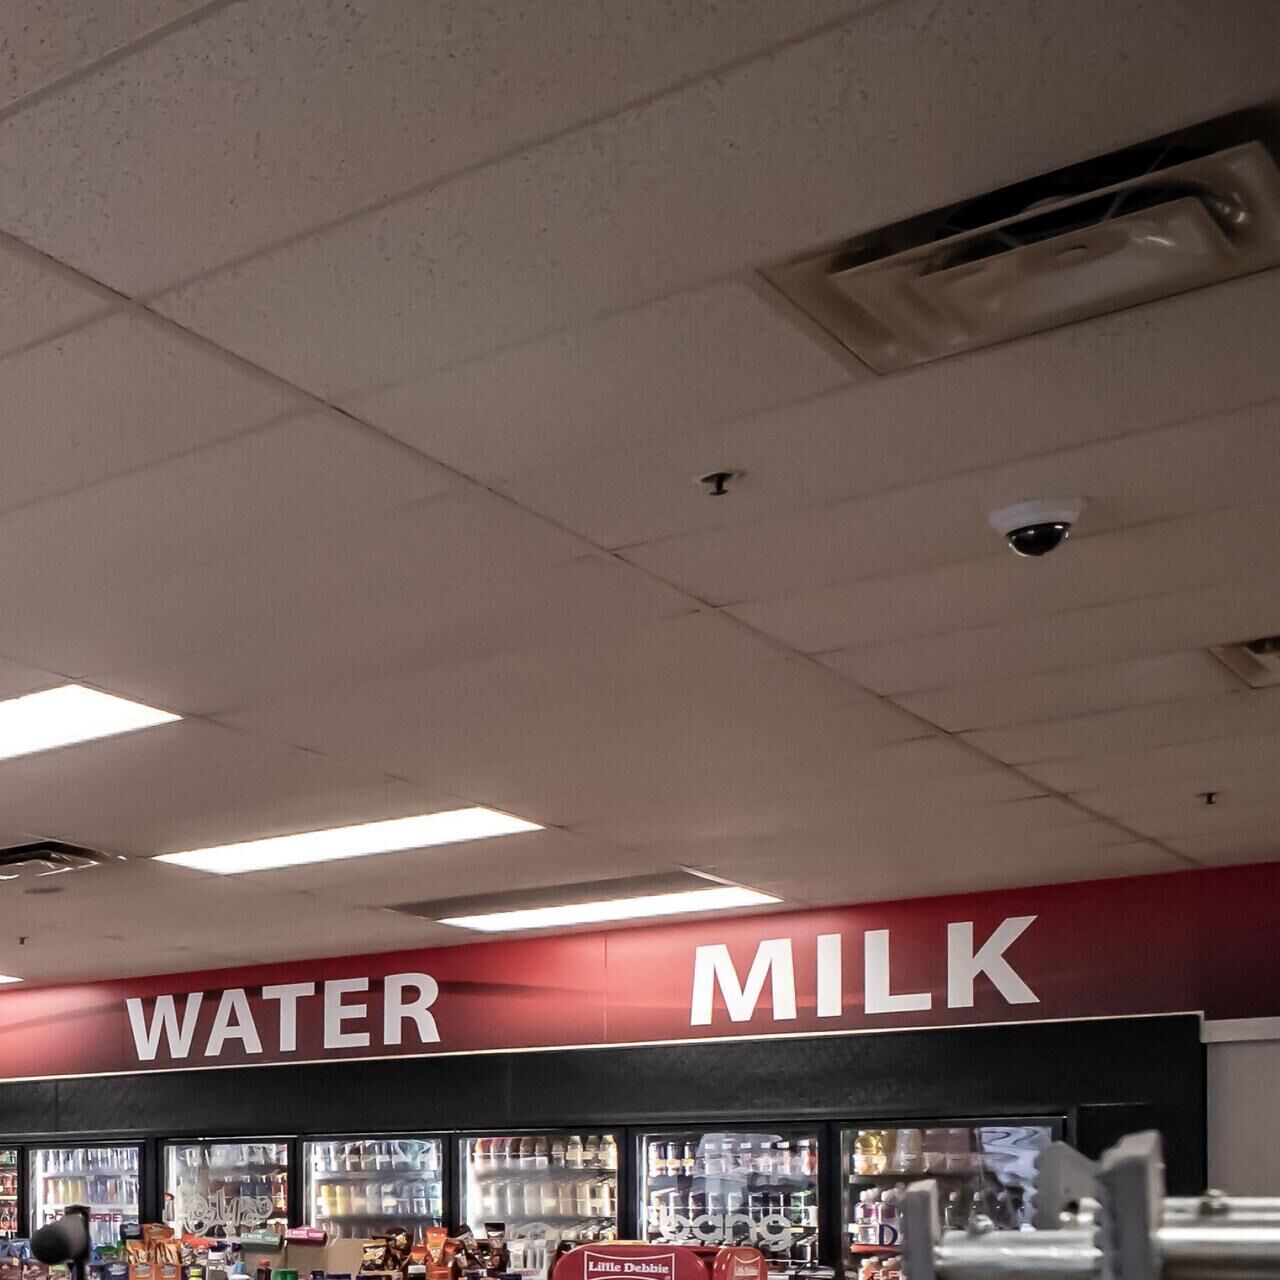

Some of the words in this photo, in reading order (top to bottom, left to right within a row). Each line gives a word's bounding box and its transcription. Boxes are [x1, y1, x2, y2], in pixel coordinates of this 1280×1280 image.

[690, 915, 1041, 1026] MILK
[125, 972, 442, 1061] WATER
[656, 1200, 792, 1251] bang
[587, 1260, 622, 1274] Little
[623, 1262, 670, 1275] Debbie
